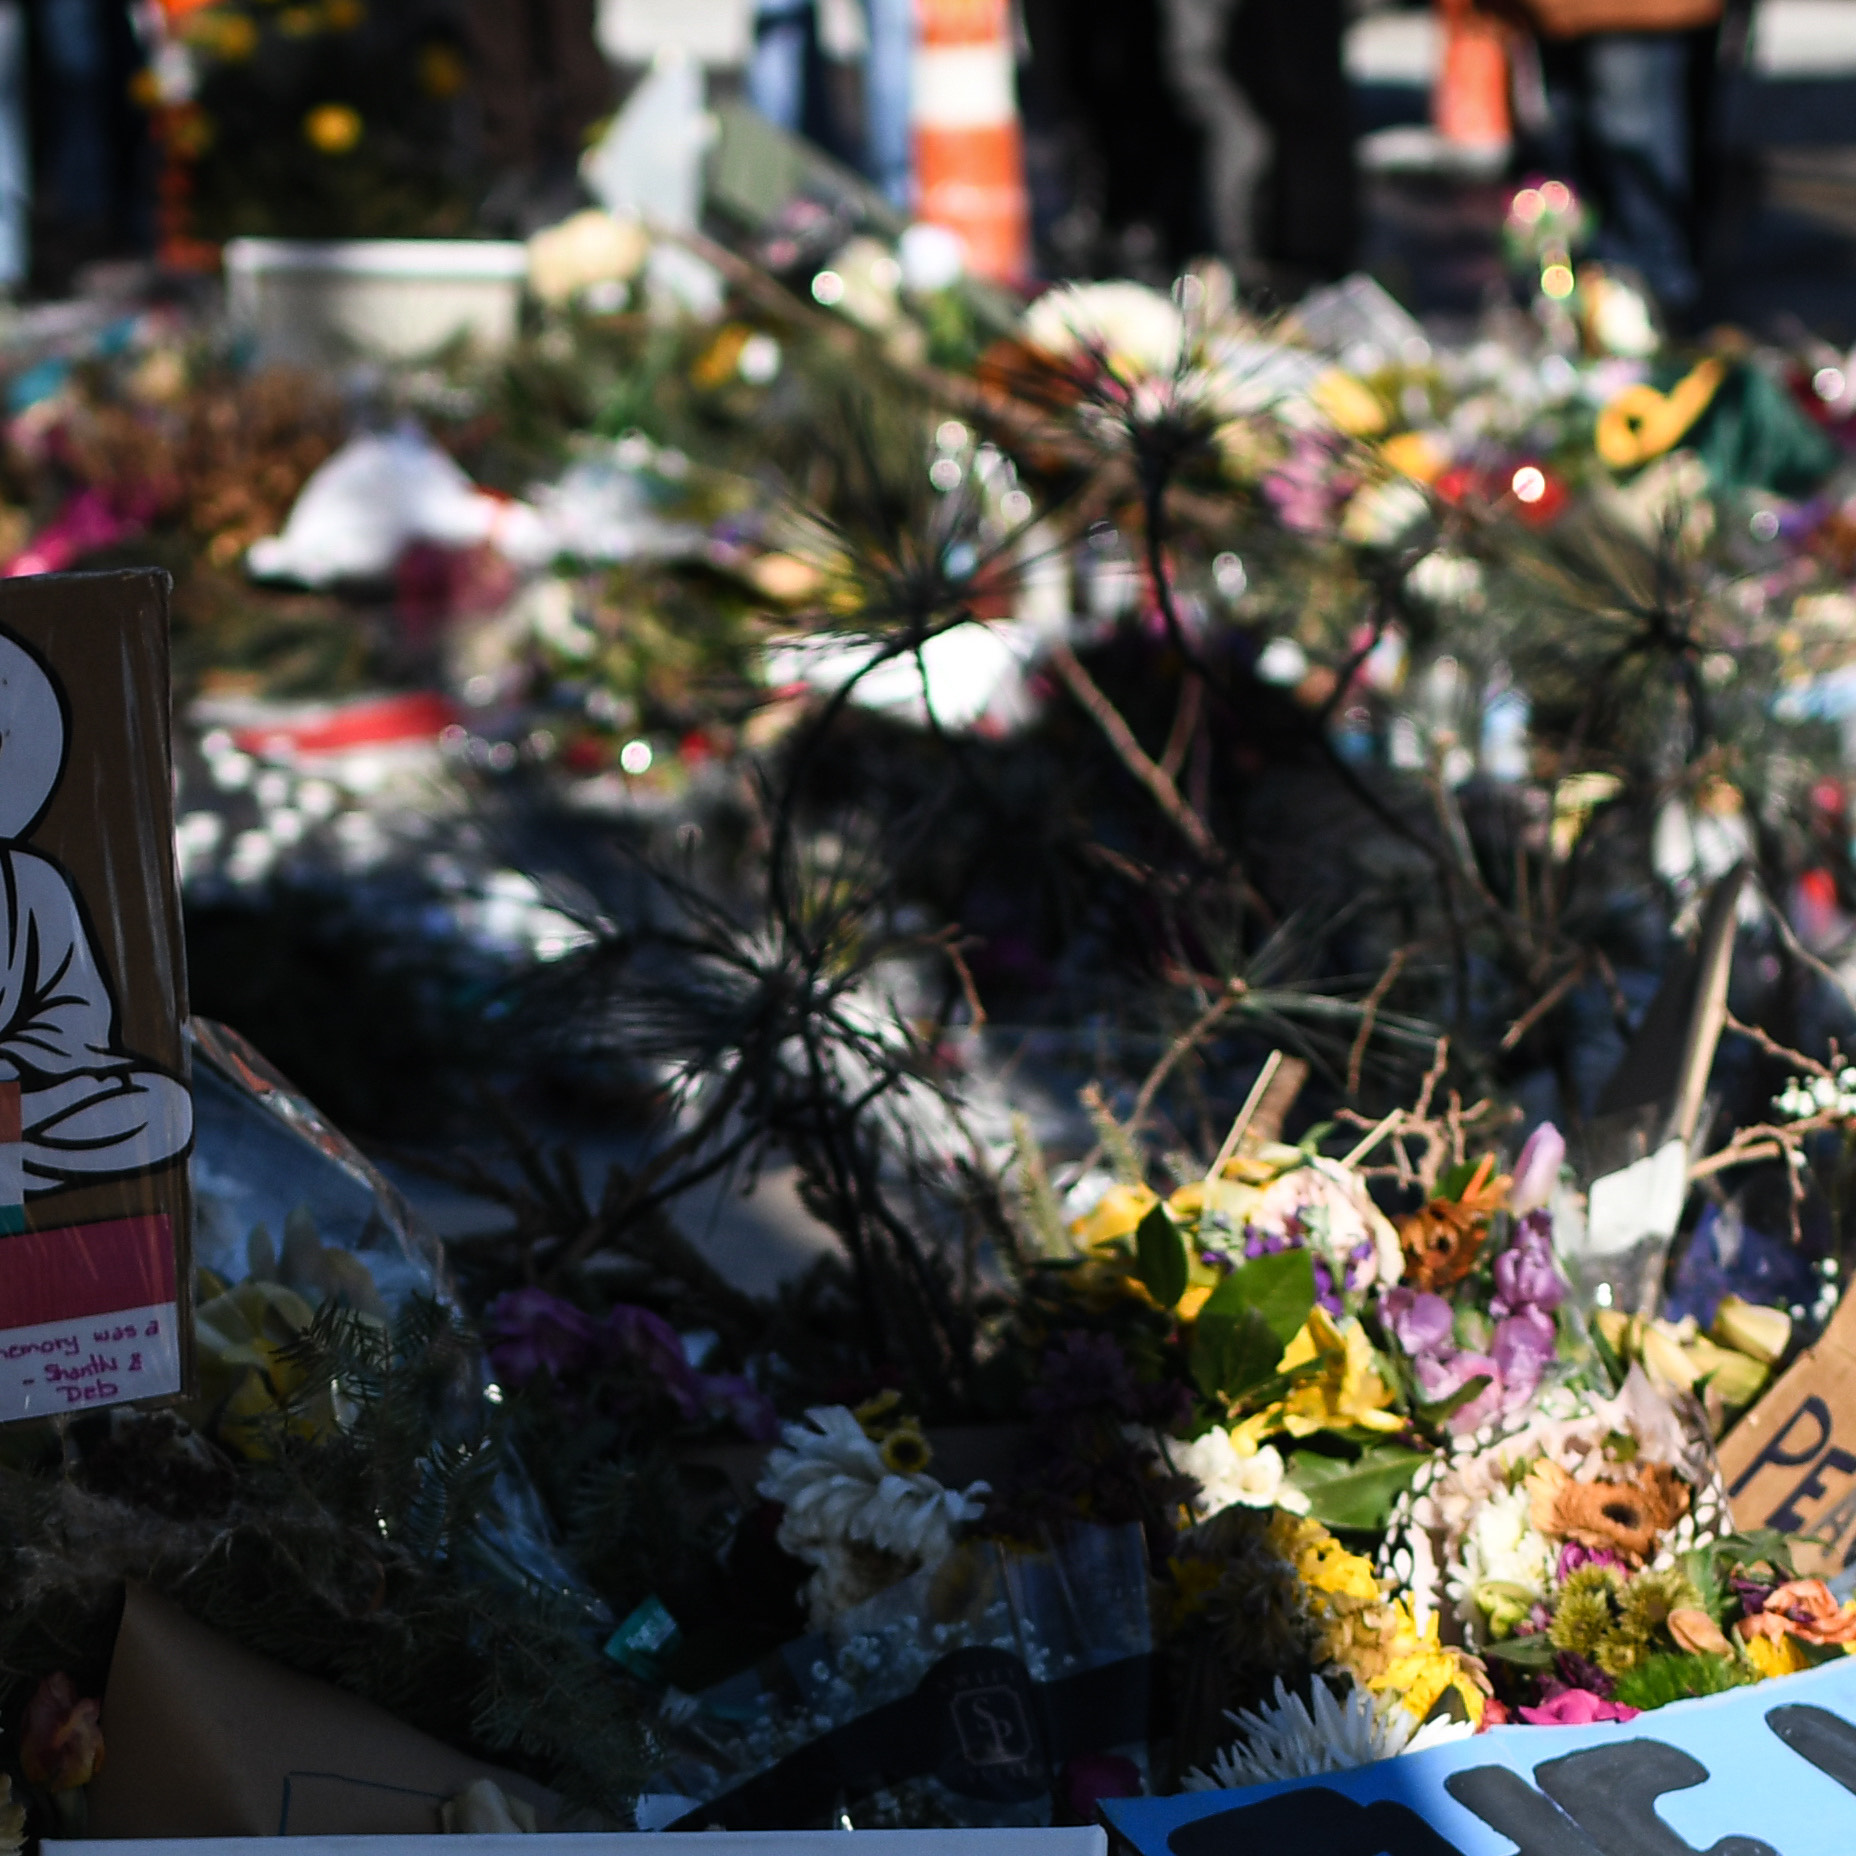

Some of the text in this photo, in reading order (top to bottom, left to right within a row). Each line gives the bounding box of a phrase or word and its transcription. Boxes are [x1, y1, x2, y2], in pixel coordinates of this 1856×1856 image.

[92, 1322, 138, 1344] was
[144, 1319, 160, 1339] a
[55, 1378, 120, 1404] Deb
